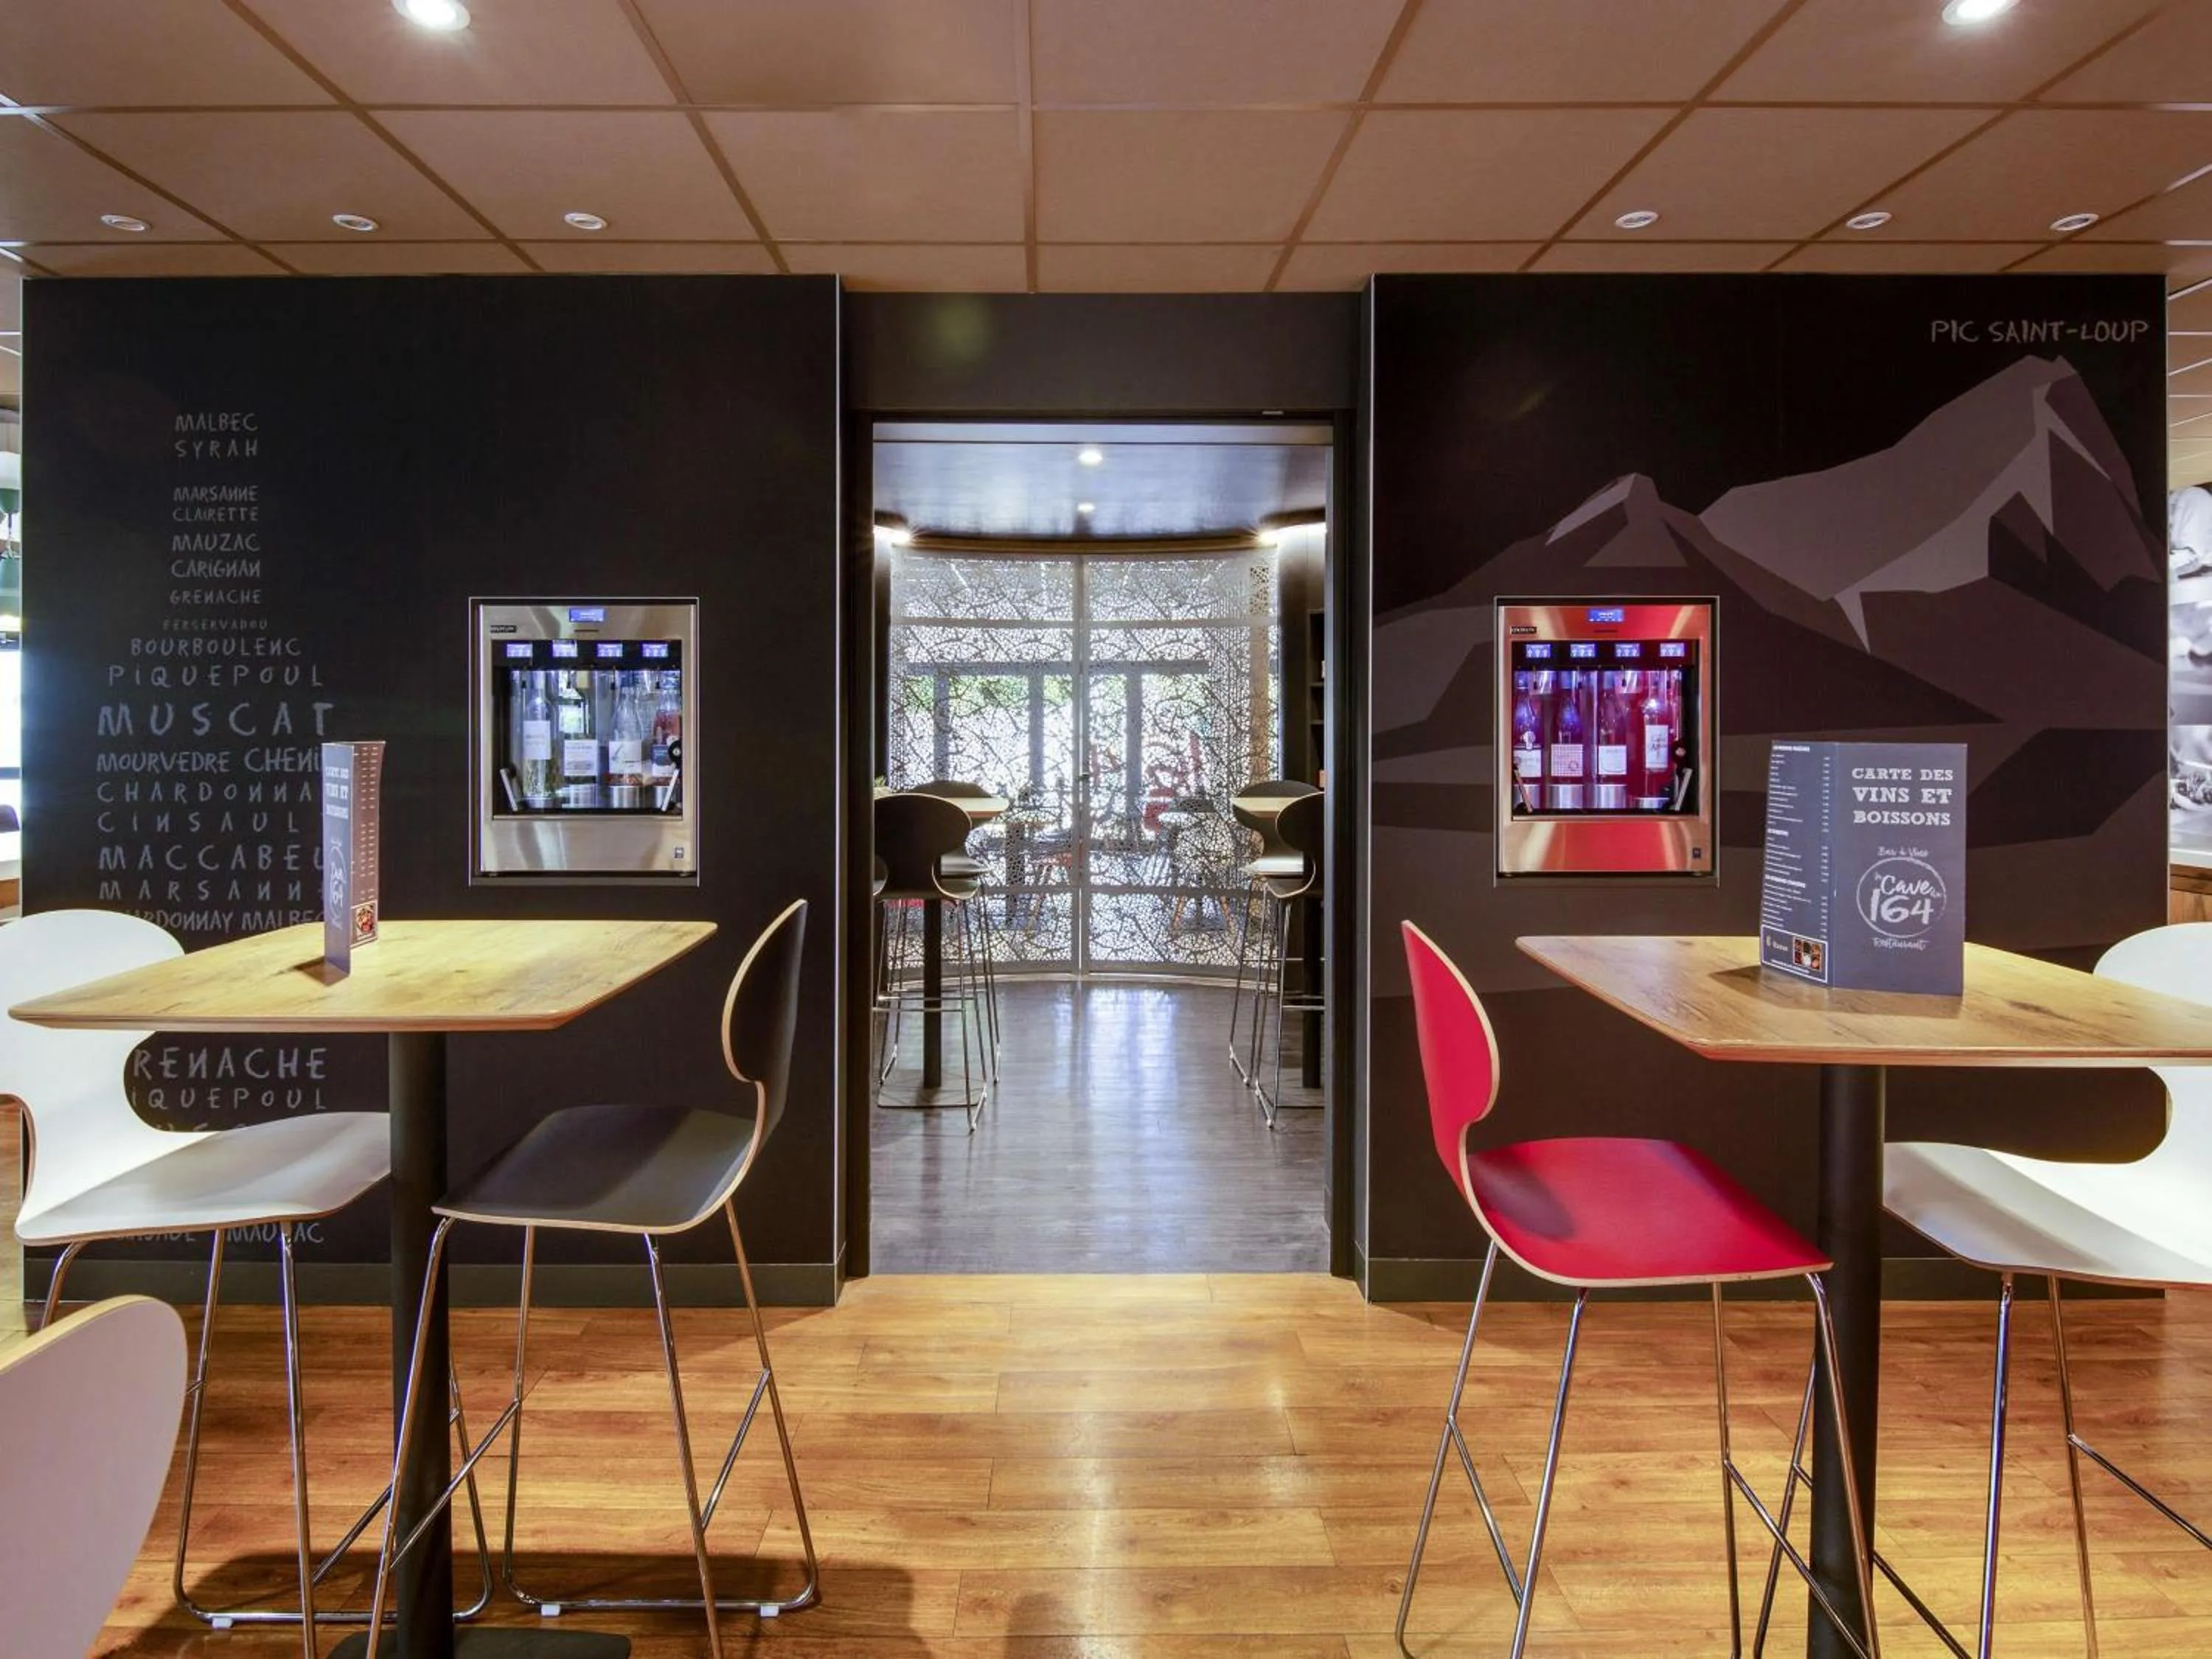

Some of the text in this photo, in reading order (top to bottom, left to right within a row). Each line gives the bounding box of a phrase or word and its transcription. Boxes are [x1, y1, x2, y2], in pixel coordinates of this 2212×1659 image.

[1929, 319, 2150, 344] PIC SAINT-LOUP
[174, 412, 259, 432] MALBEC
[174, 439, 258, 460] SYRAH
[172, 484, 259, 502] MARSANNE
[172, 507, 259, 524] CLAIRETTE
[171, 532, 260, 552] MAUZAC
[170, 558, 261, 580] CARIGNAN
[169, 589, 262, 605] GRENACHE
[130, 636, 302, 658] BOURBOULENC
[108, 664, 324, 689] PIQUEPOUL
[97, 700, 335, 737] MUSCAT
[96, 749, 232, 775] MOURVEDRE
[243, 745, 319, 773] CHENI
[1851, 768, 1954, 782] CARTE DES
[97, 781, 313, 805] CHARDONNA
[1852, 787, 1953, 804] VINS ET
[97, 810, 303, 834] CINSAUL
[1852, 810, 1951, 827] BOISSONS
[98, 878, 324, 903] MARSANN
[1881, 874, 1930, 895] Cave
[1870, 888, 1935, 925] 164
[133, 1046, 329, 1081] RENACHE
[226, 1221, 326, 1245] MAUAC
